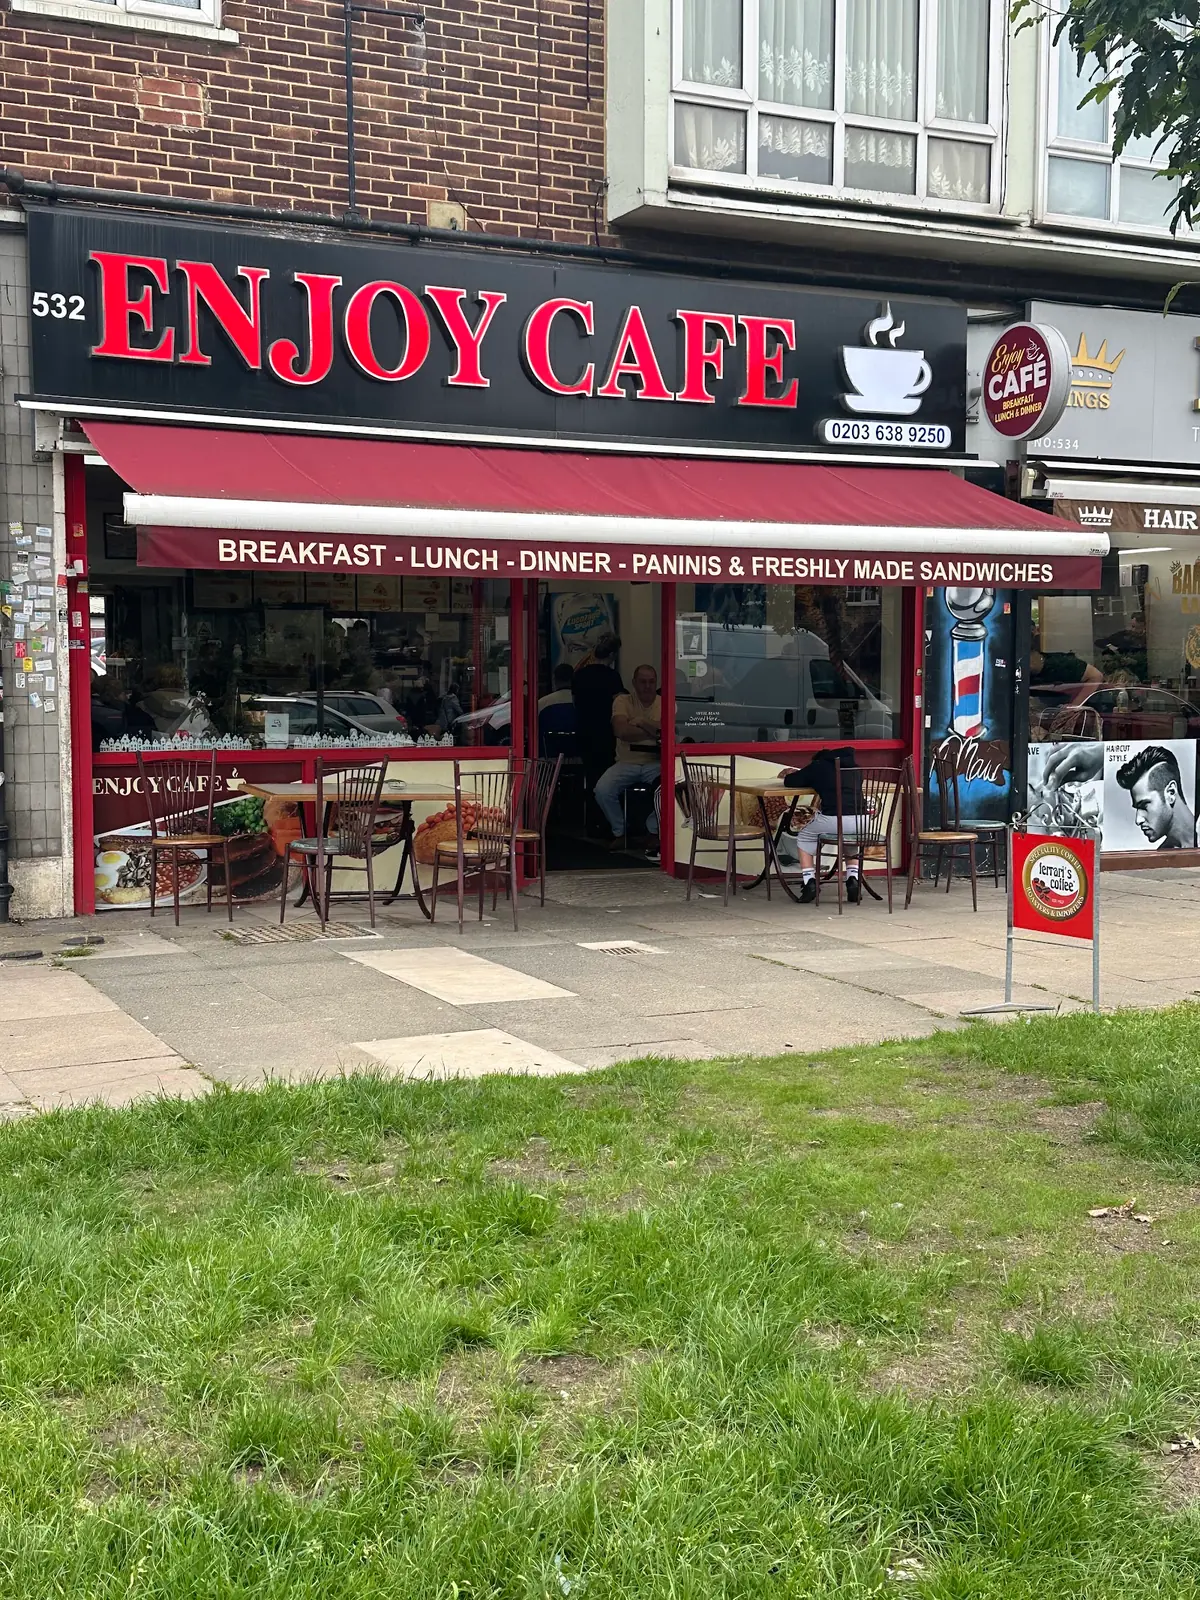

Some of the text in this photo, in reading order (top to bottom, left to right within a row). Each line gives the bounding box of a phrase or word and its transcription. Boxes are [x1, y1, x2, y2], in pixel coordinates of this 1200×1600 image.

[32, 291, 86, 322] 532
[89, 250, 799, 409] ENJOY CAFE
[991, 342, 1025, 375] Enjoy
[988, 353, 1048, 401] CAFÉ
[994, 402, 1043, 423] LUNCH & DINNER
[1002, 393, 1035, 410] BREAKFAST
[832, 422, 945, 444] 0203 638 9250
[1034, 437, 1079, 450] NO:534
[1143, 508, 1199, 530] HAIR
[218, 538, 386, 567] BREAKFAST
[410, 546, 499, 571] LUNCH
[519, 550, 611, 573] DINNER
[632, 553, 722, 577] PANINIS
[728, 556, 746, 577] &
[752, 556, 850, 580] FRESHLY
[853, 558, 915, 580] MADE
[920, 561, 1054, 583] SANDWICHES
[1106, 745, 1130, 753] HAIRCUT
[166, 775, 223, 793] CAFE
[1060, 849, 1083, 872] COFFEE
[1026, 886, 1049, 915] ROASTERS
[1056, 896, 1085, 917] IMPORTERS
